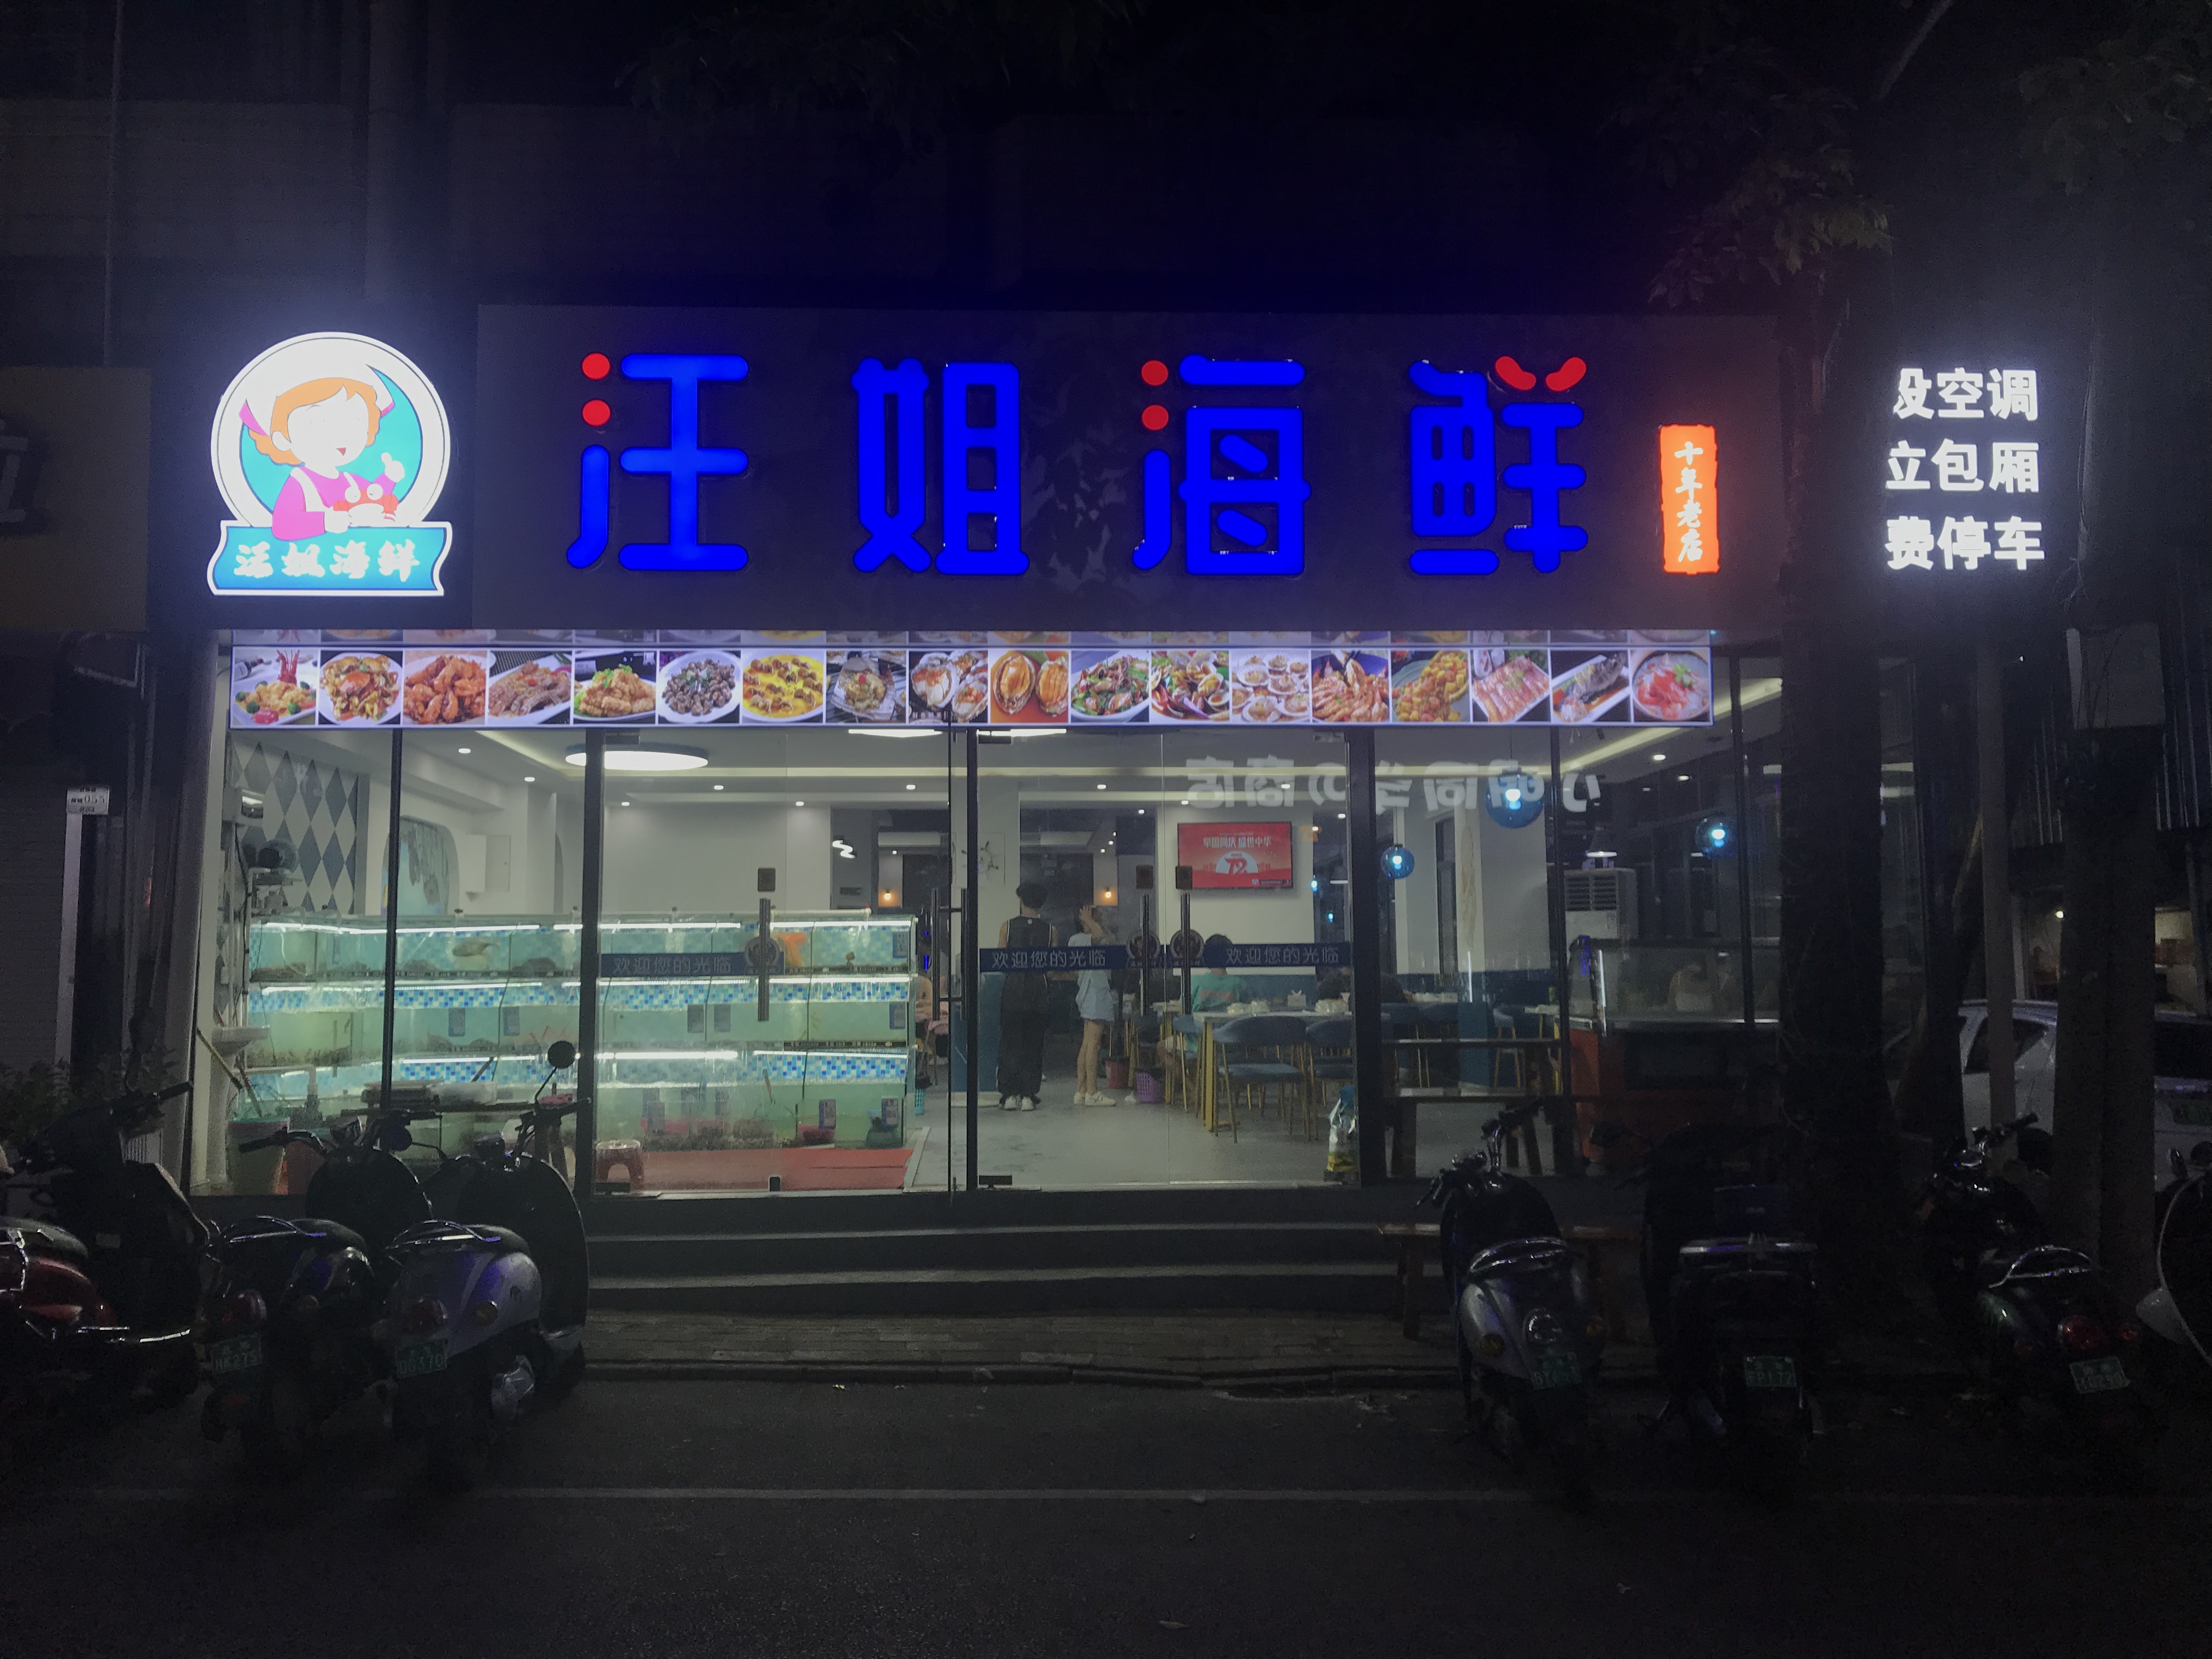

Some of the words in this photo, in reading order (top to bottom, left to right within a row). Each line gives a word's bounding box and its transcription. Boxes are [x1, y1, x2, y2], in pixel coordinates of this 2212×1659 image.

[566, 352, 1588, 575] 汪姐海鲜
[1885, 437, 2040, 493] 立包厢
[1674, 441, 1703, 562] 十年老店
[234, 539, 420, 582] 汪姐海鲜
[1885, 515, 2045, 571] 费停车
[613, 955, 731, 974] 欢迎您的光临
[991, 949, 1107, 969] 欢迎您的光临
[1226, 945, 1340, 966] 欢迎您的光临
